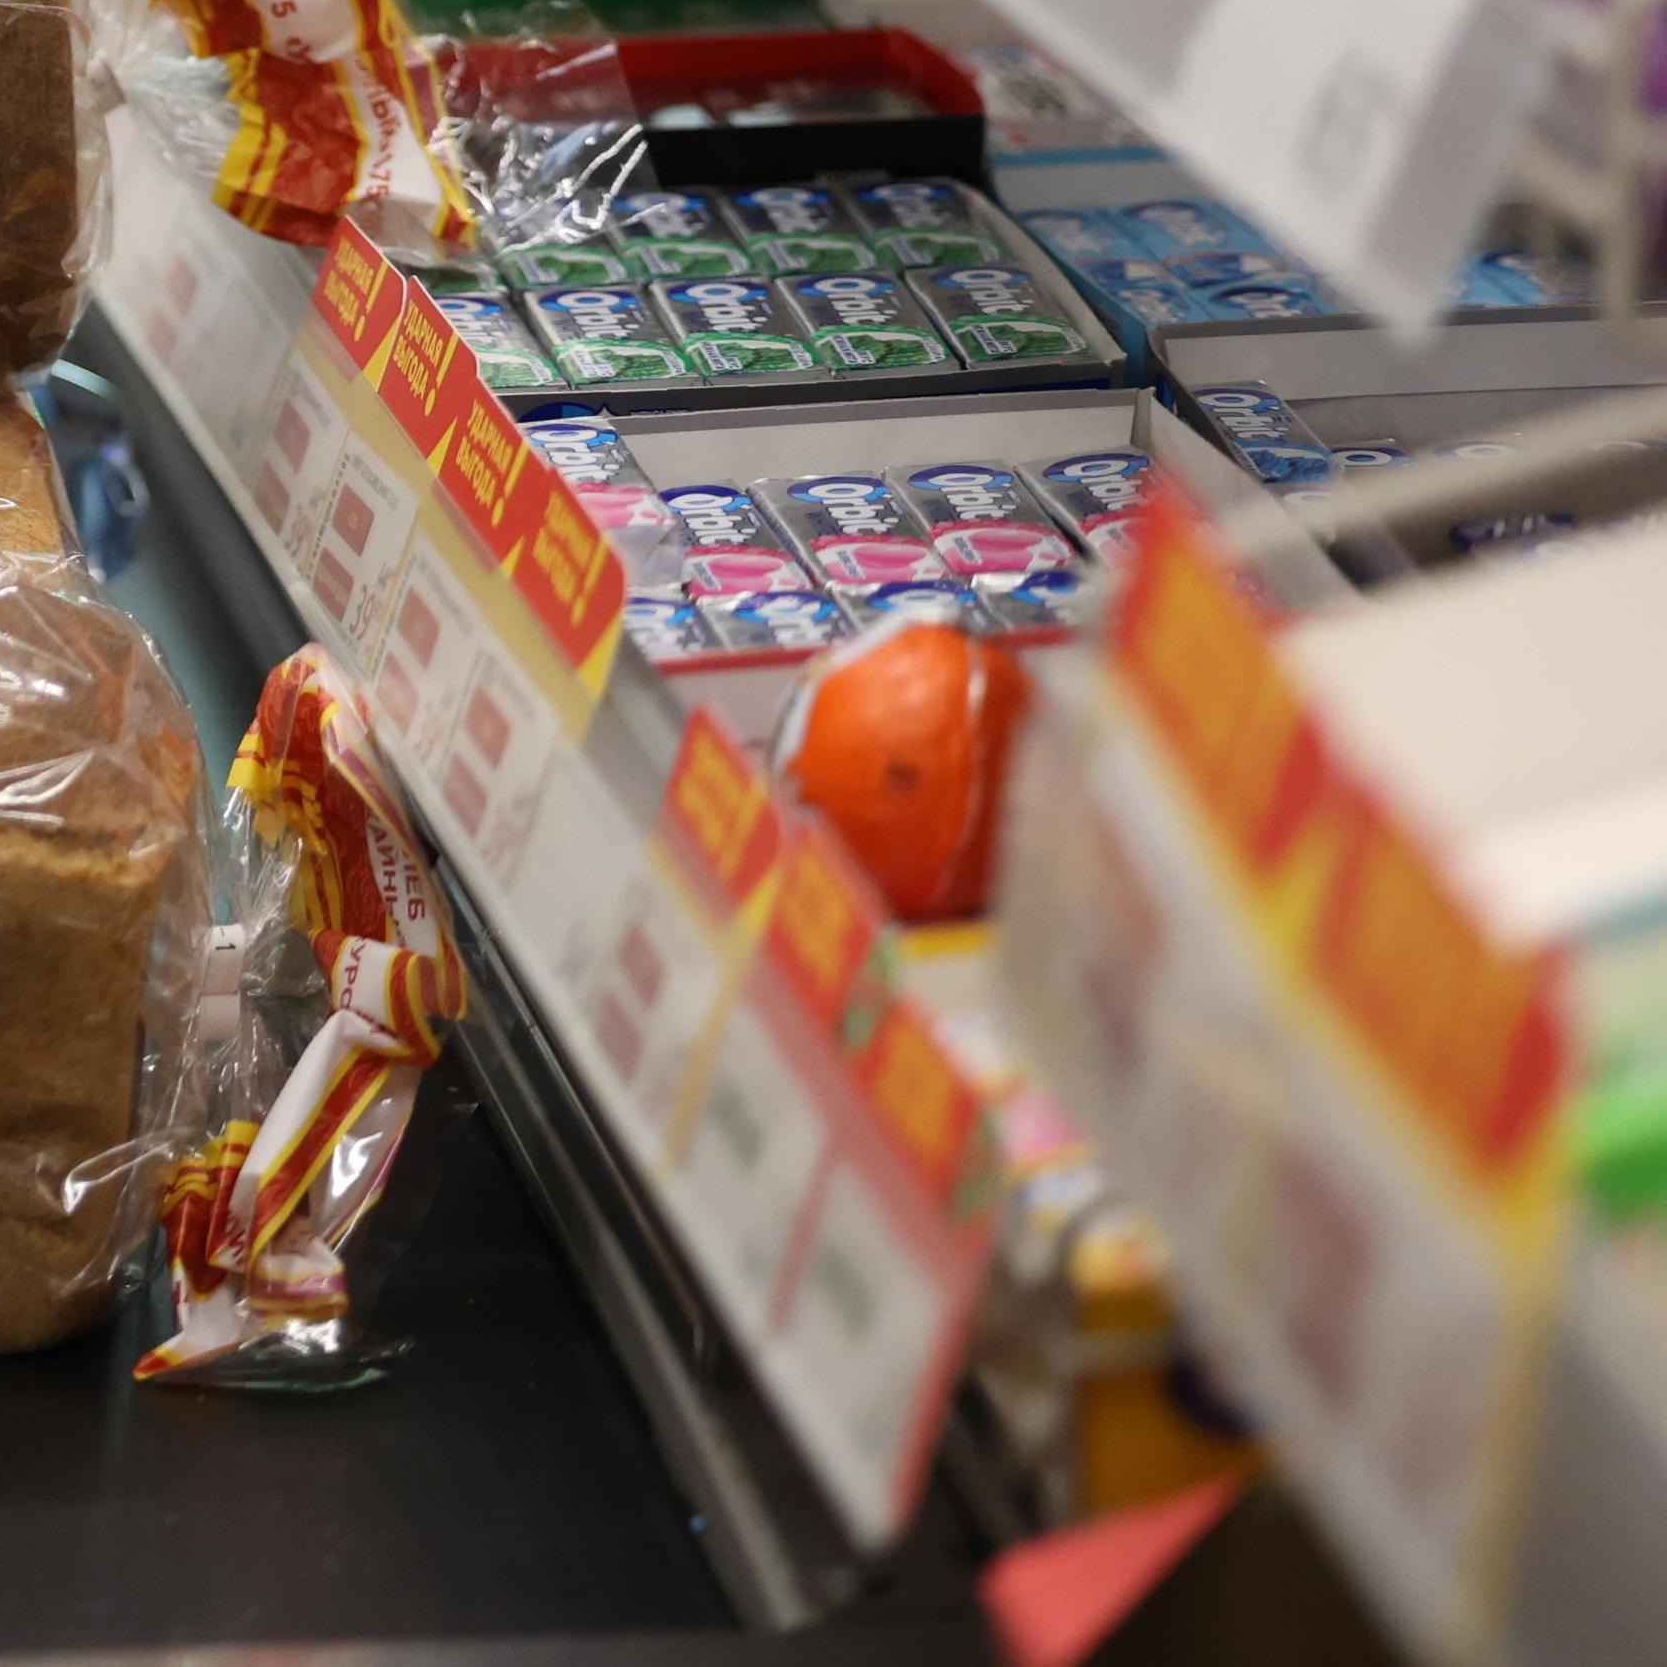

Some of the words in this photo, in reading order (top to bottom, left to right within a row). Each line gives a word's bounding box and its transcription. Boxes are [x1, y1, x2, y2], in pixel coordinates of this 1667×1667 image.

[813, 277, 898, 324] Orbit
[404, 298, 443, 365] УДАРНАЯ
[392, 333, 431, 401] ВЫГОДА
[467, 400, 514, 476] УДАРНАЯ
[1197, 392, 1291, 440] Orbit
[455, 434, 498, 507] ВЫГОДА
[928, 472, 1017, 521] Orbit
[666, 492, 759, 547] Orbit
[807, 481, 901, 535] Orbit
